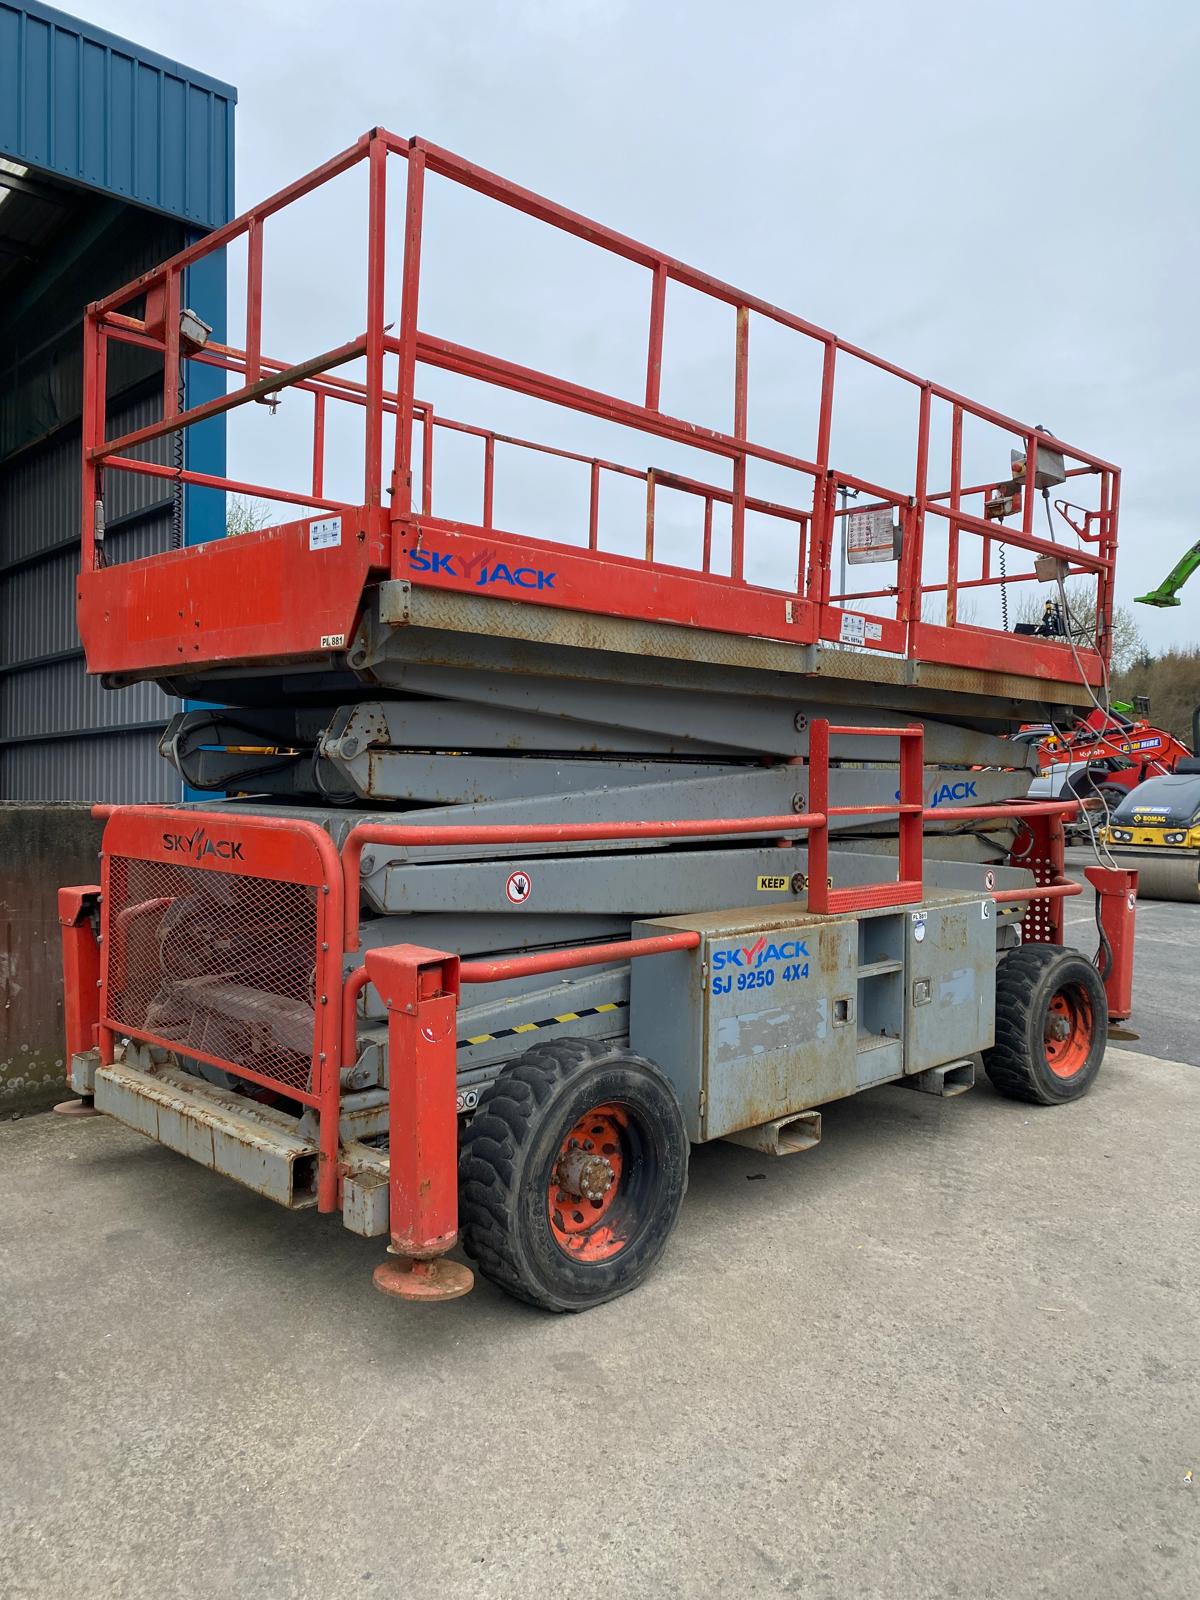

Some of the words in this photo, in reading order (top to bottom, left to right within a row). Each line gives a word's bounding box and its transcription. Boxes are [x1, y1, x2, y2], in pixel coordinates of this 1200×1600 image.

[409, 549, 557, 590] SKYJACK
[332, 636, 343, 645] 881
[163, 827, 246, 861] SKYJACK
[761, 878, 785, 889] KEEP
[712, 937, 811, 971] SKYJACK
[712, 975, 732, 995] SJ
[737, 968, 775, 991] 9250
[782, 962, 809, 982] 4X4
